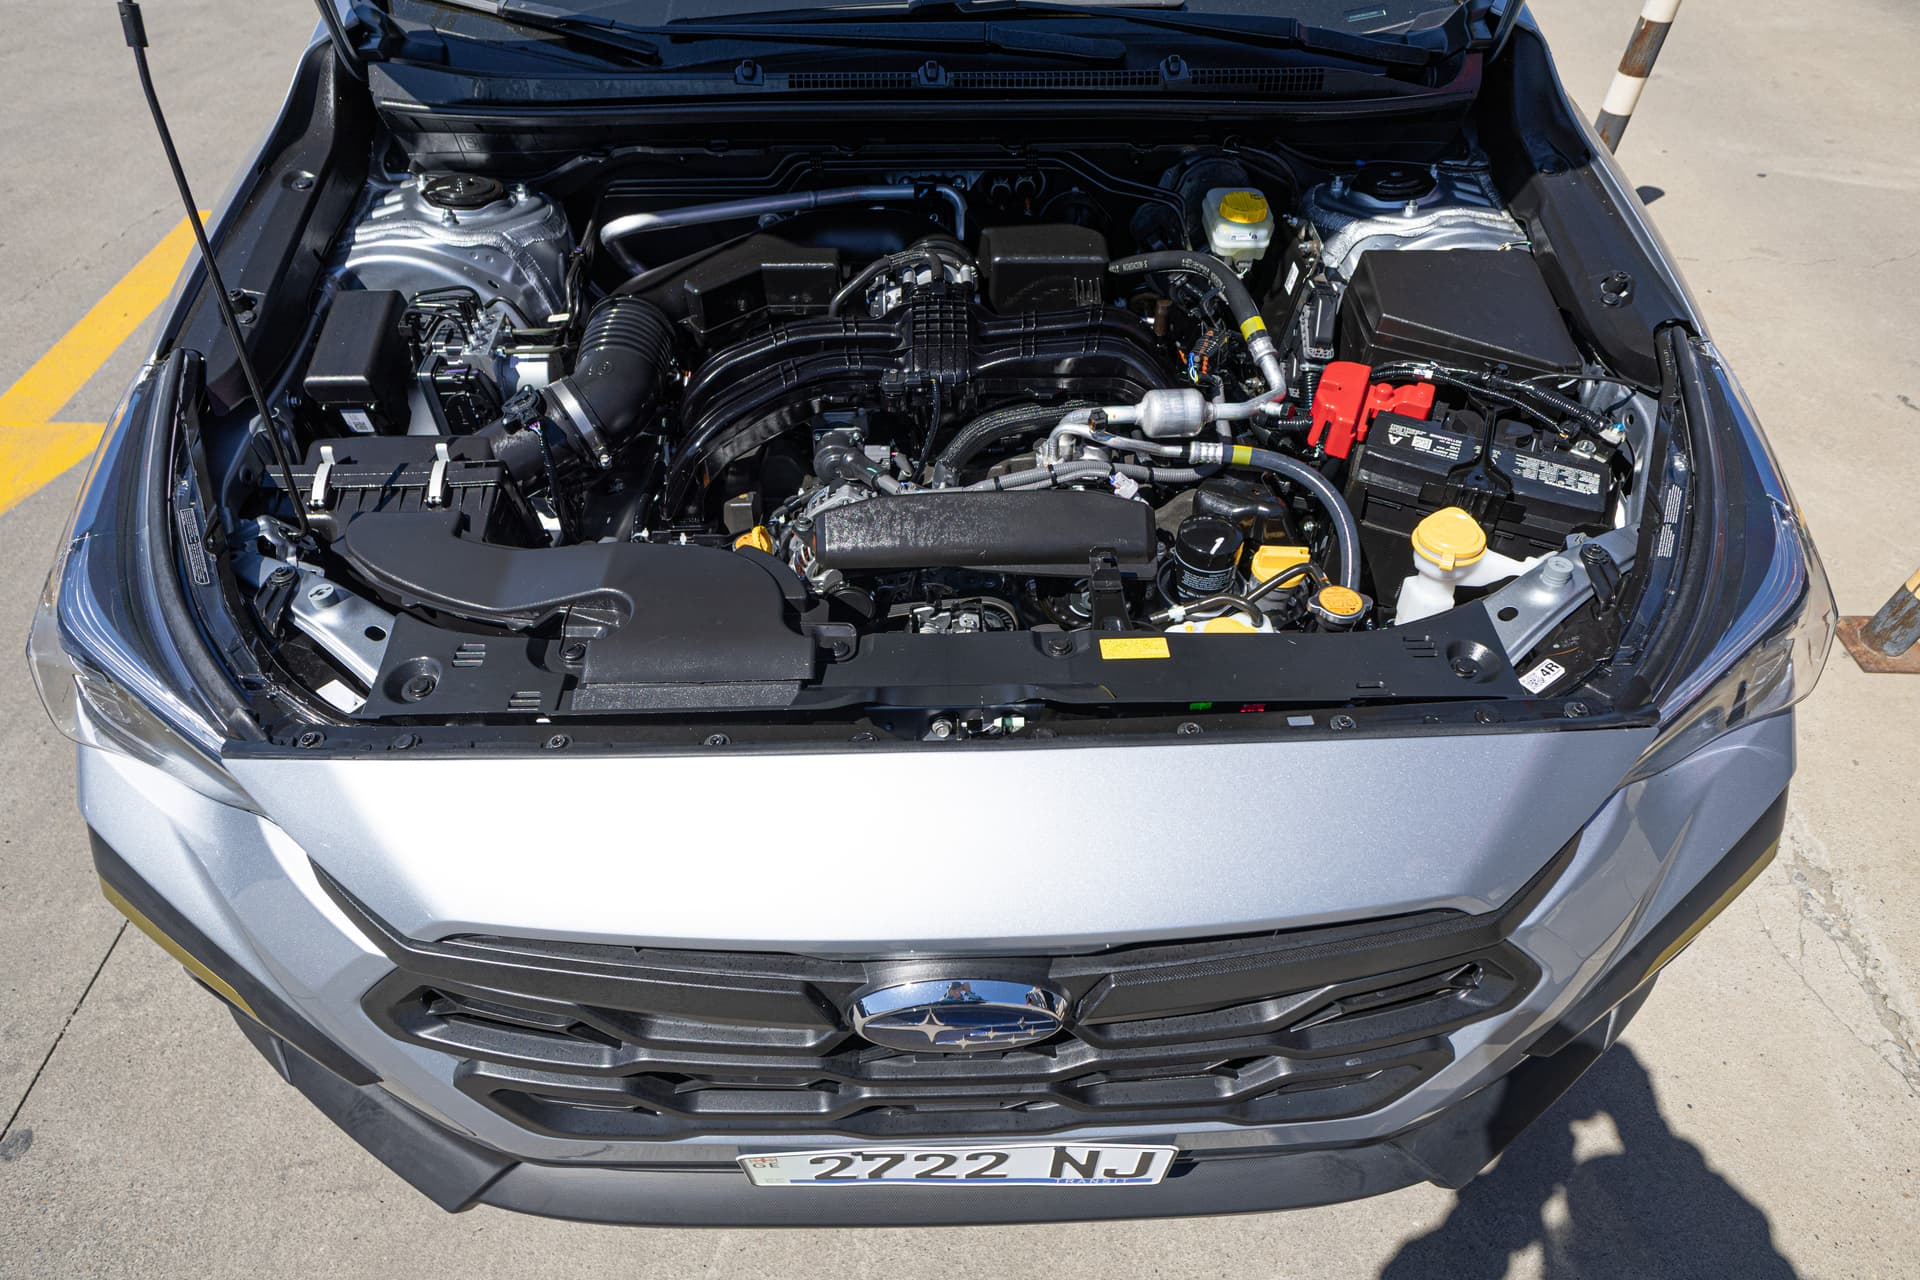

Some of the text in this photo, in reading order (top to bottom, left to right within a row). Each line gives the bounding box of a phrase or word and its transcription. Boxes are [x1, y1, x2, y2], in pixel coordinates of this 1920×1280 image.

[1540, 662, 1560, 678] 4R
[809, 1150, 1156, 1179] 2722 NJ
